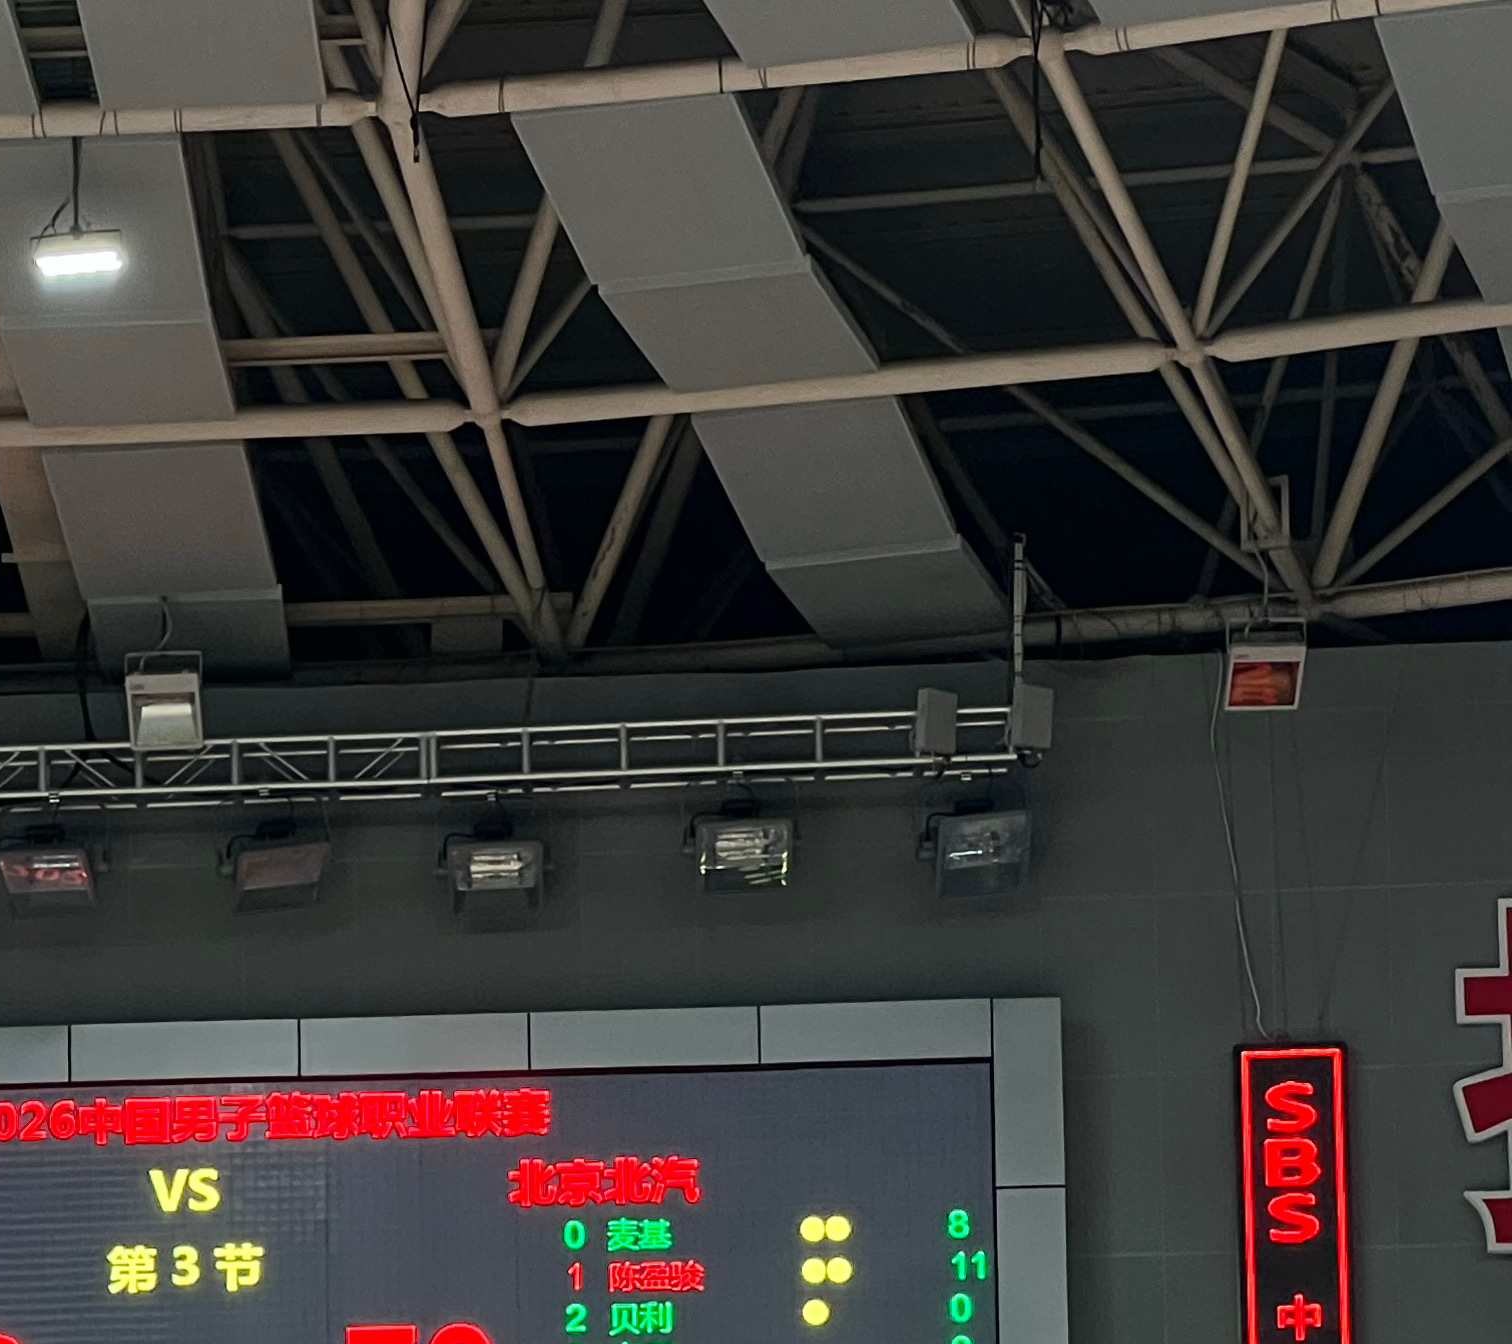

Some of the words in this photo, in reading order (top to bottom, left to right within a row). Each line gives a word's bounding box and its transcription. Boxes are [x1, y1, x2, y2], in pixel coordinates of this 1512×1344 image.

[507, 1155, 702, 1208] 北京北汽
[1263, 1081, 1322, 1243] SBS
[149, 1167, 221, 1213] VS
[563, 1220, 587, 1250] 0
[607, 1218, 673, 1252] 麦基
[947, 1209, 971, 1239] 8
[568, 1262, 583, 1291] 1
[607, 1259, 706, 1293] 陈盈骏
[951, 1249, 990, 1280] 11
[565, 1303, 588, 1334] 2
[609, 1301, 675, 1335] 贝利
[949, 1293, 975, 1324] 0
